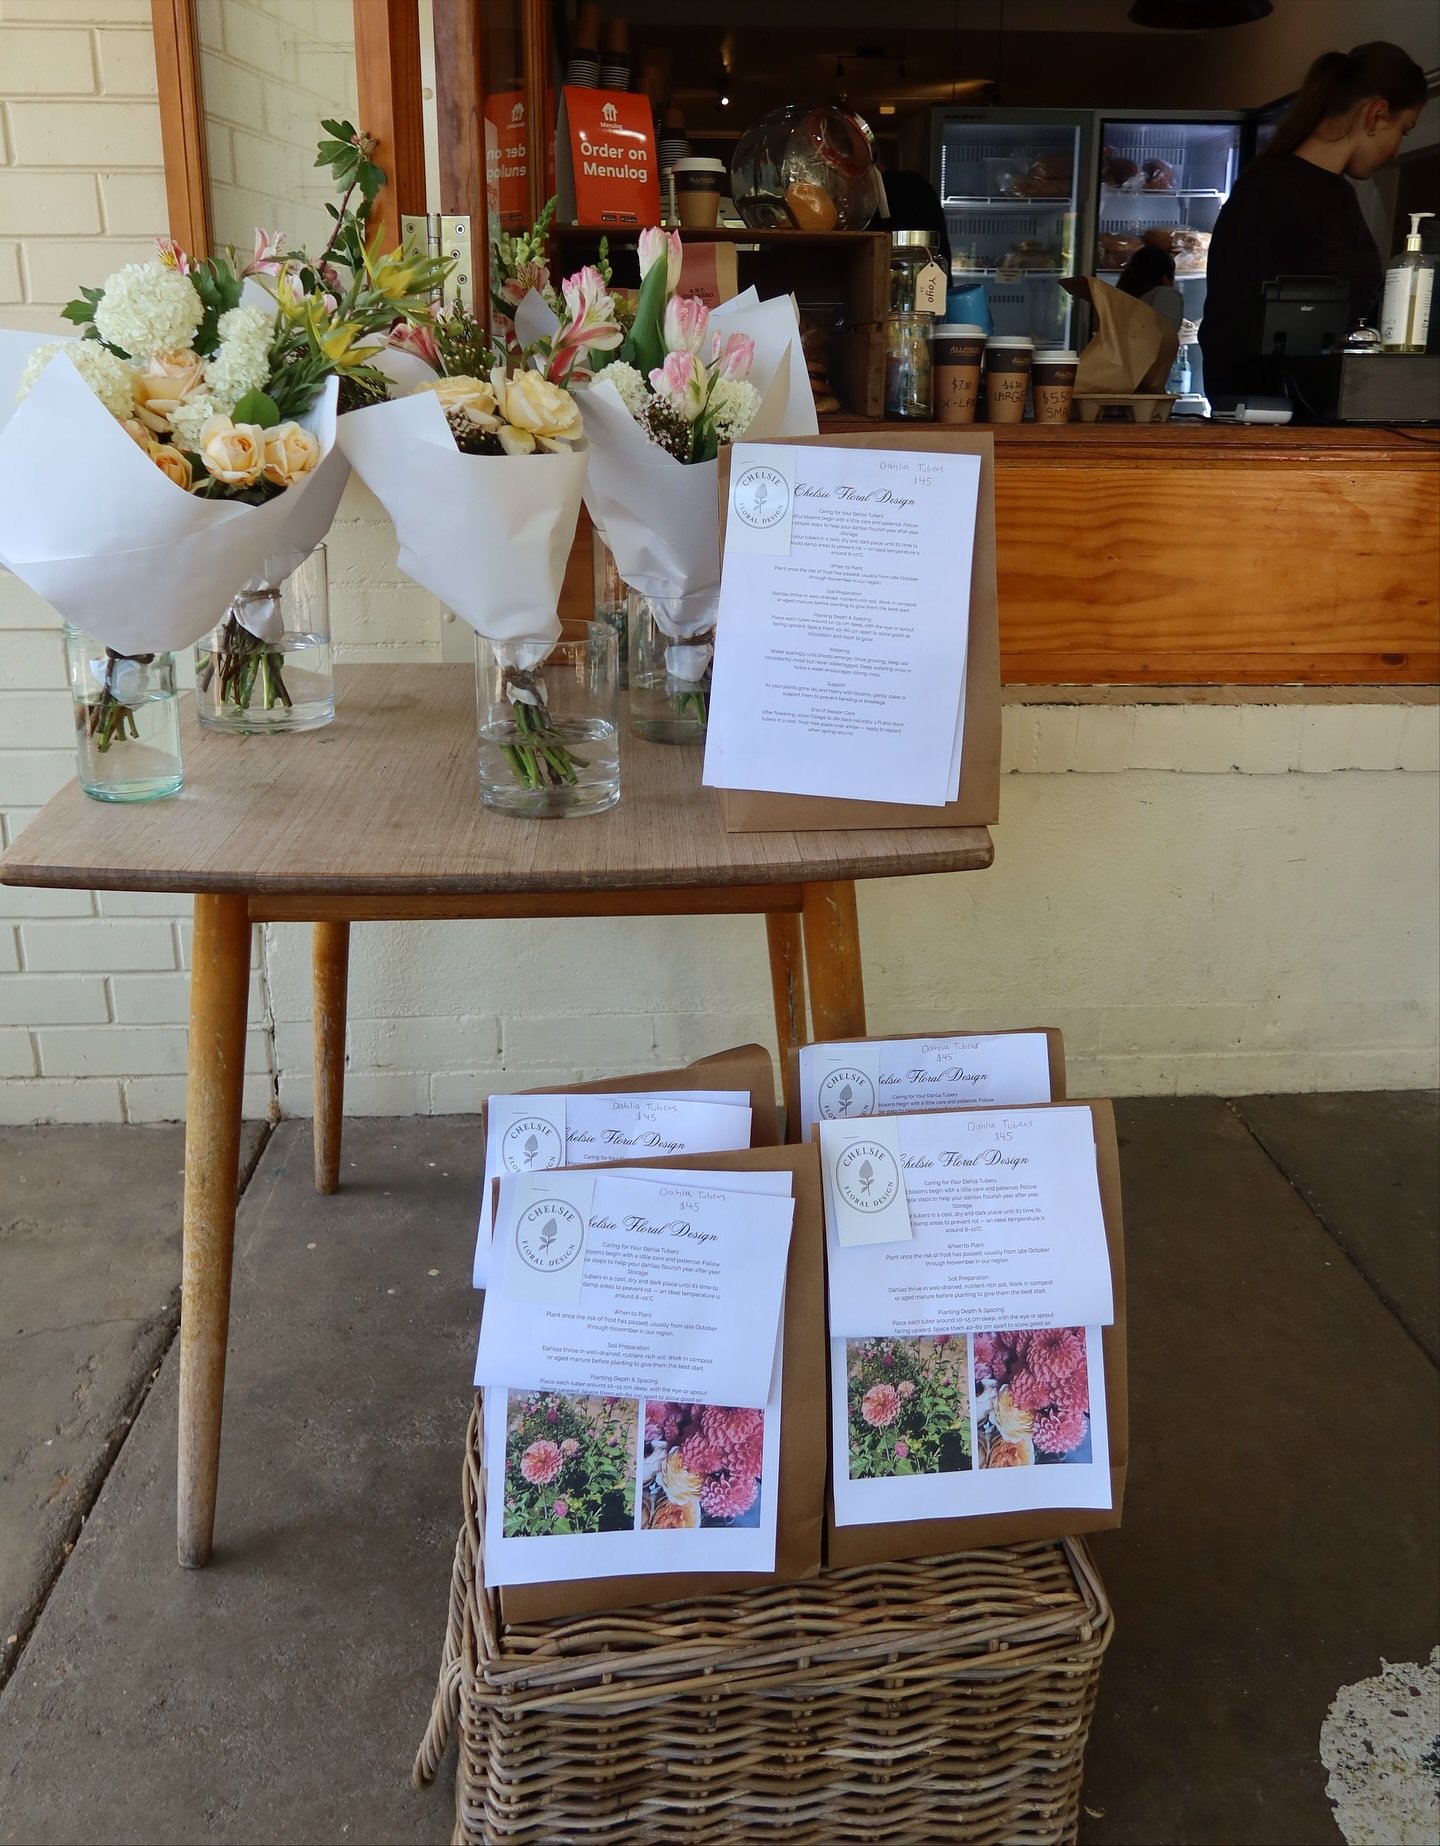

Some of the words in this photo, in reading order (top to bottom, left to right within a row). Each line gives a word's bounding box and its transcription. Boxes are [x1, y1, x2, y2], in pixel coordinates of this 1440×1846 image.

[600, 122, 622, 130] Menulog
[580, 141, 624, 159] Order
[628, 150, 647, 160] on
[583, 162, 648, 183] Menulog
[926, 276, 936, 303] Yoyo
[994, 391, 1025, 403] LARGE
[1042, 390, 1071, 404] $5.50
[879, 461, 910, 471] Dahlia
[917, 462, 944, 473] Tubers
[742, 472, 781, 486] CHELSIE
[794, 482, 830, 498] Chelsie
[835, 486, 874, 502] Floral
[874, 488, 916, 508] Design
[739, 502, 758, 523] FLORAL
[762, 505, 783, 524] DESIGN
[922, 1044, 949, 1054] Dahlia
[954, 1042, 981, 1050] Tubers
[936, 1053, 953, 1062] $45
[826, 1072, 866, 1089] CHELSIE
[906, 1068, 943, 1084] Floral
[945, 1067, 988, 1086] Design
[612, 1102, 640, 1111] Dahlia
[646, 1102, 678, 1112] Tubers
[636, 1113, 656, 1122] $45
[967, 1121, 996, 1132] Dahlia
[1002, 1119, 1033, 1129] Tubers
[510, 1122, 553, 1140] CHELSIE
[994, 1132, 1014, 1141] $45
[600, 1129, 642, 1145] Floral
[643, 1131, 687, 1153] Design
[843, 1147, 886, 1167] CHELSIE
[938, 1151, 979, 1168] Floral
[980, 1149, 1030, 1171] Design
[659, 1187, 691, 1197] Dahlia
[698, 1192, 726, 1200] Tubers
[844, 1186, 870, 1208] FLORAL
[874, 1181, 894, 1207] DESIGN
[528, 1204, 576, 1223] CHELSIE
[679, 1202, 700, 1212] $45
[622, 1215, 666, 1235] Floral
[668, 1220, 719, 1245] Design
[522, 1240, 544, 1266] FLORAL
[549, 1243, 576, 1266] DESIGN
[627, 1269, 648, 1277] Storage
